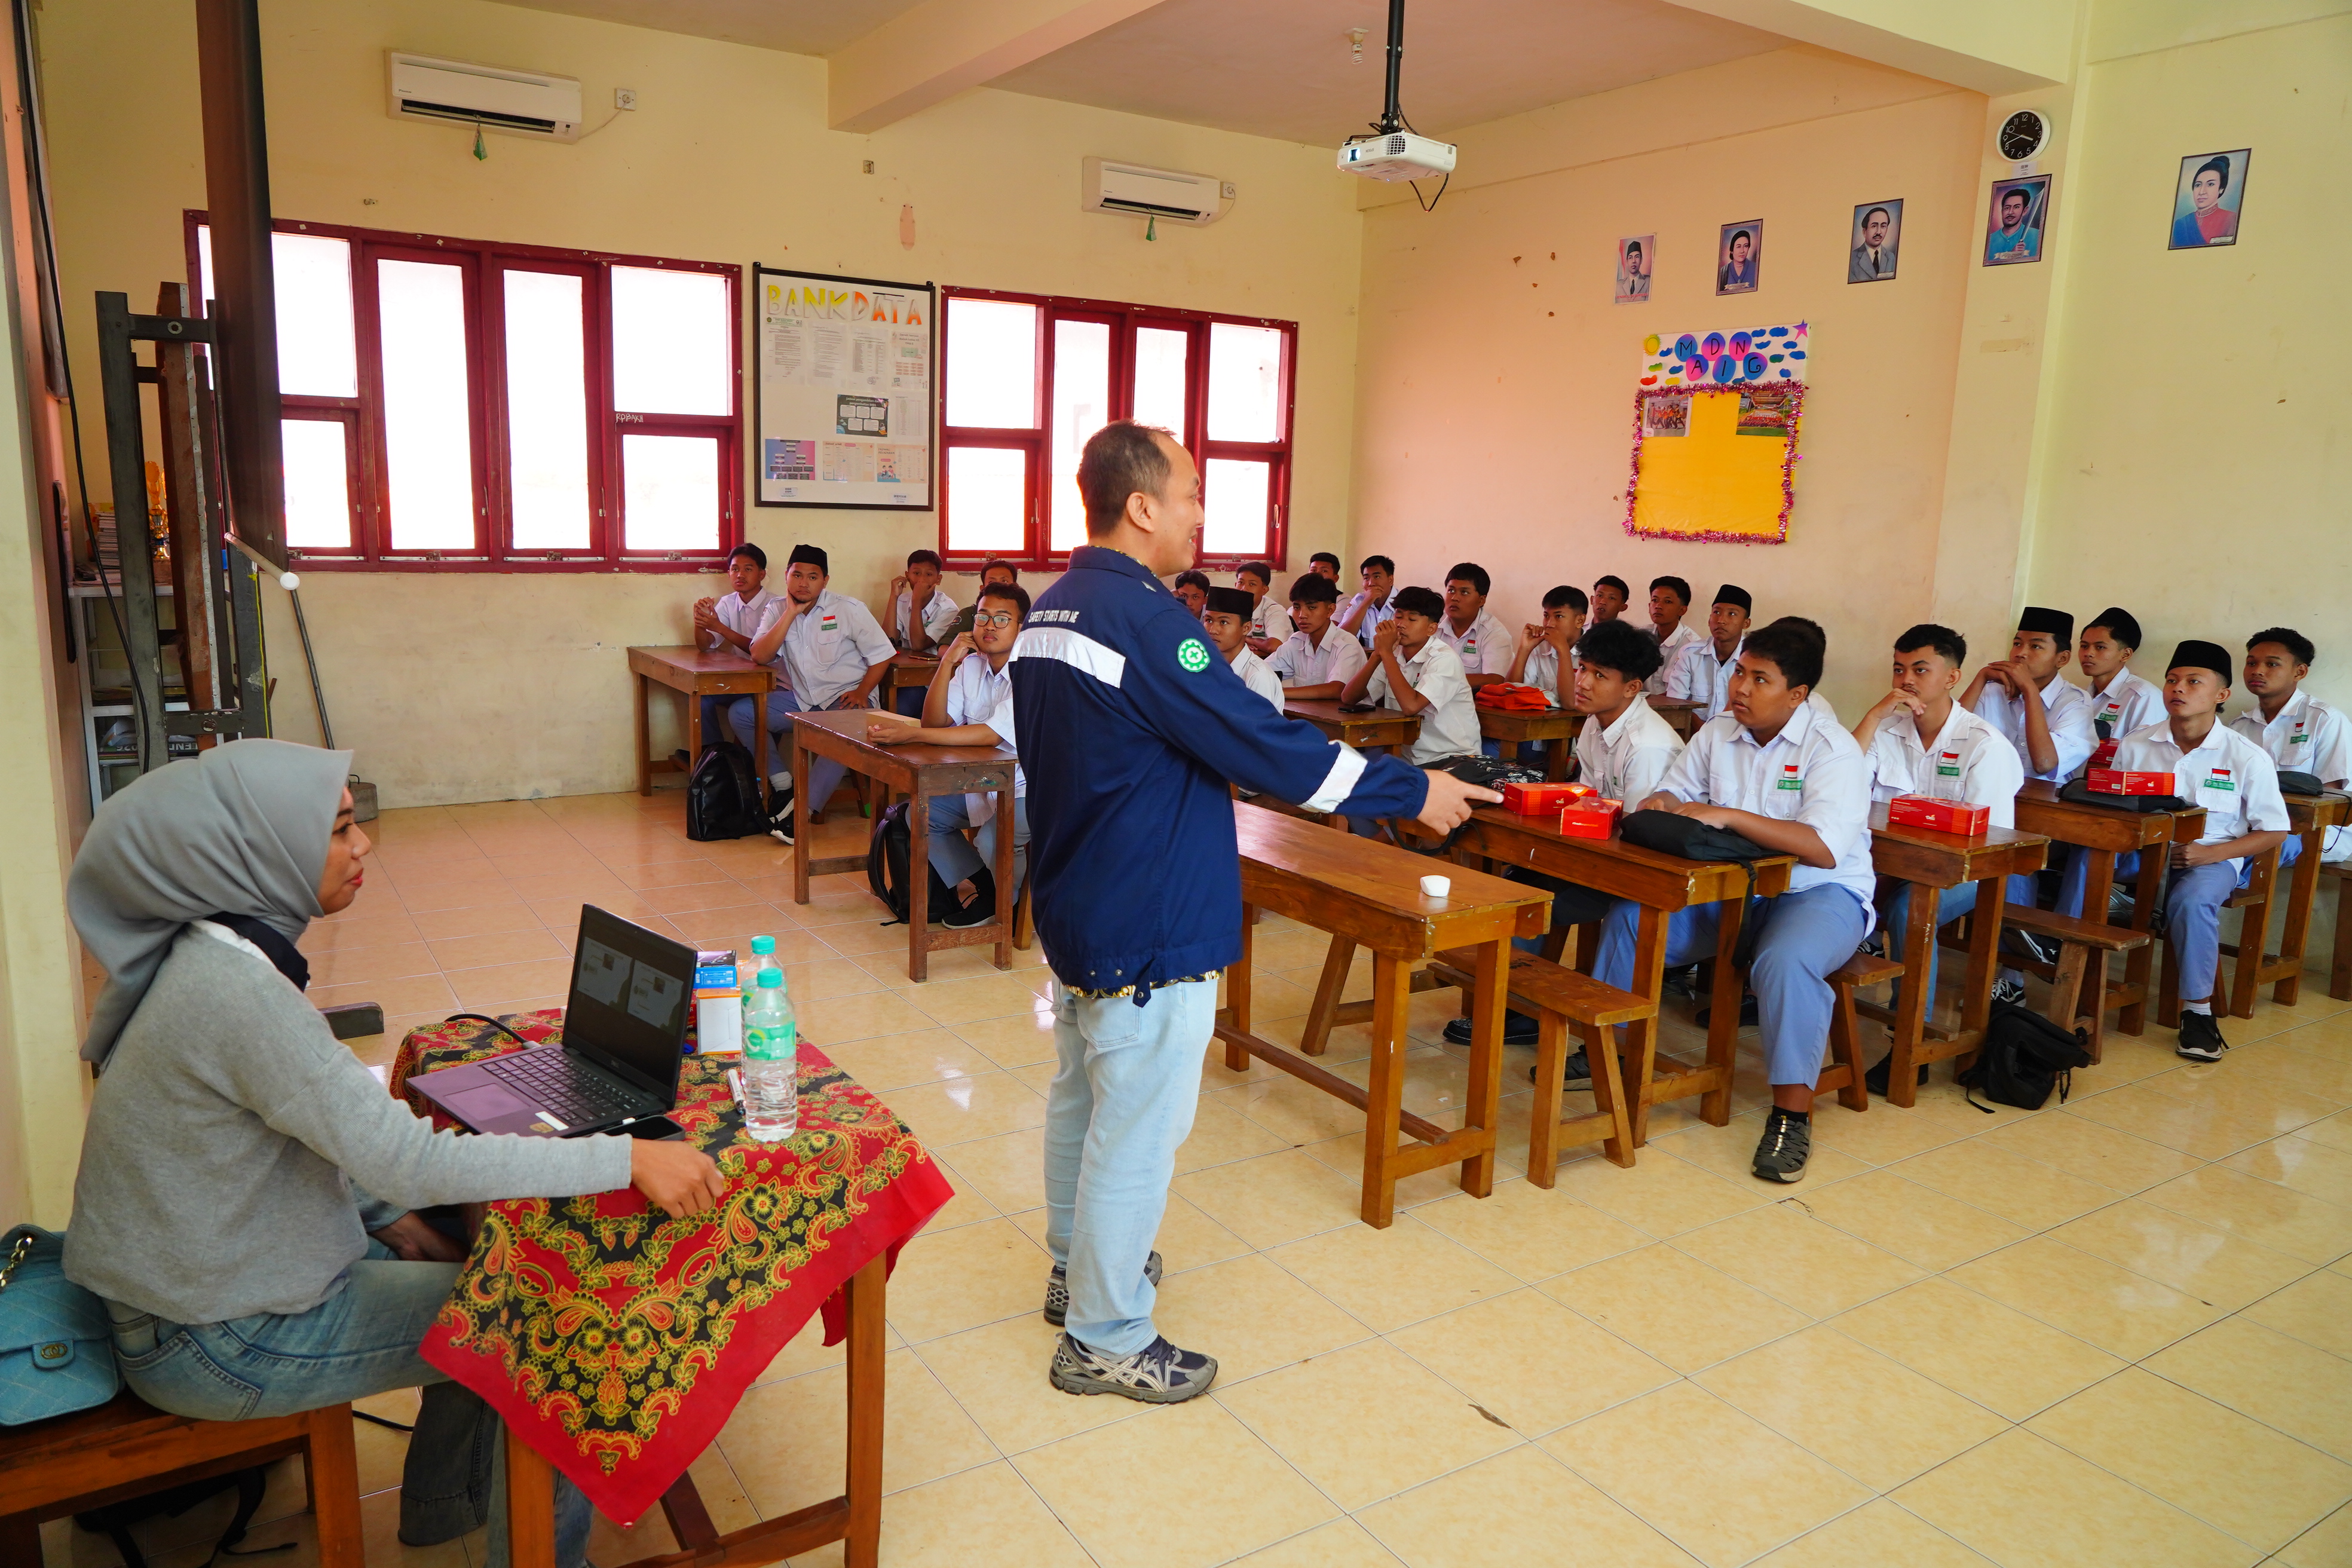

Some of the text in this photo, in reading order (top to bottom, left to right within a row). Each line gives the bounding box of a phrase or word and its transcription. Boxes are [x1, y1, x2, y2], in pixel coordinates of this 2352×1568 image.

[766, 284, 922, 325] BANK DATA
[1028, 610, 1080, 623] SAFETY STARTS WITH ME
